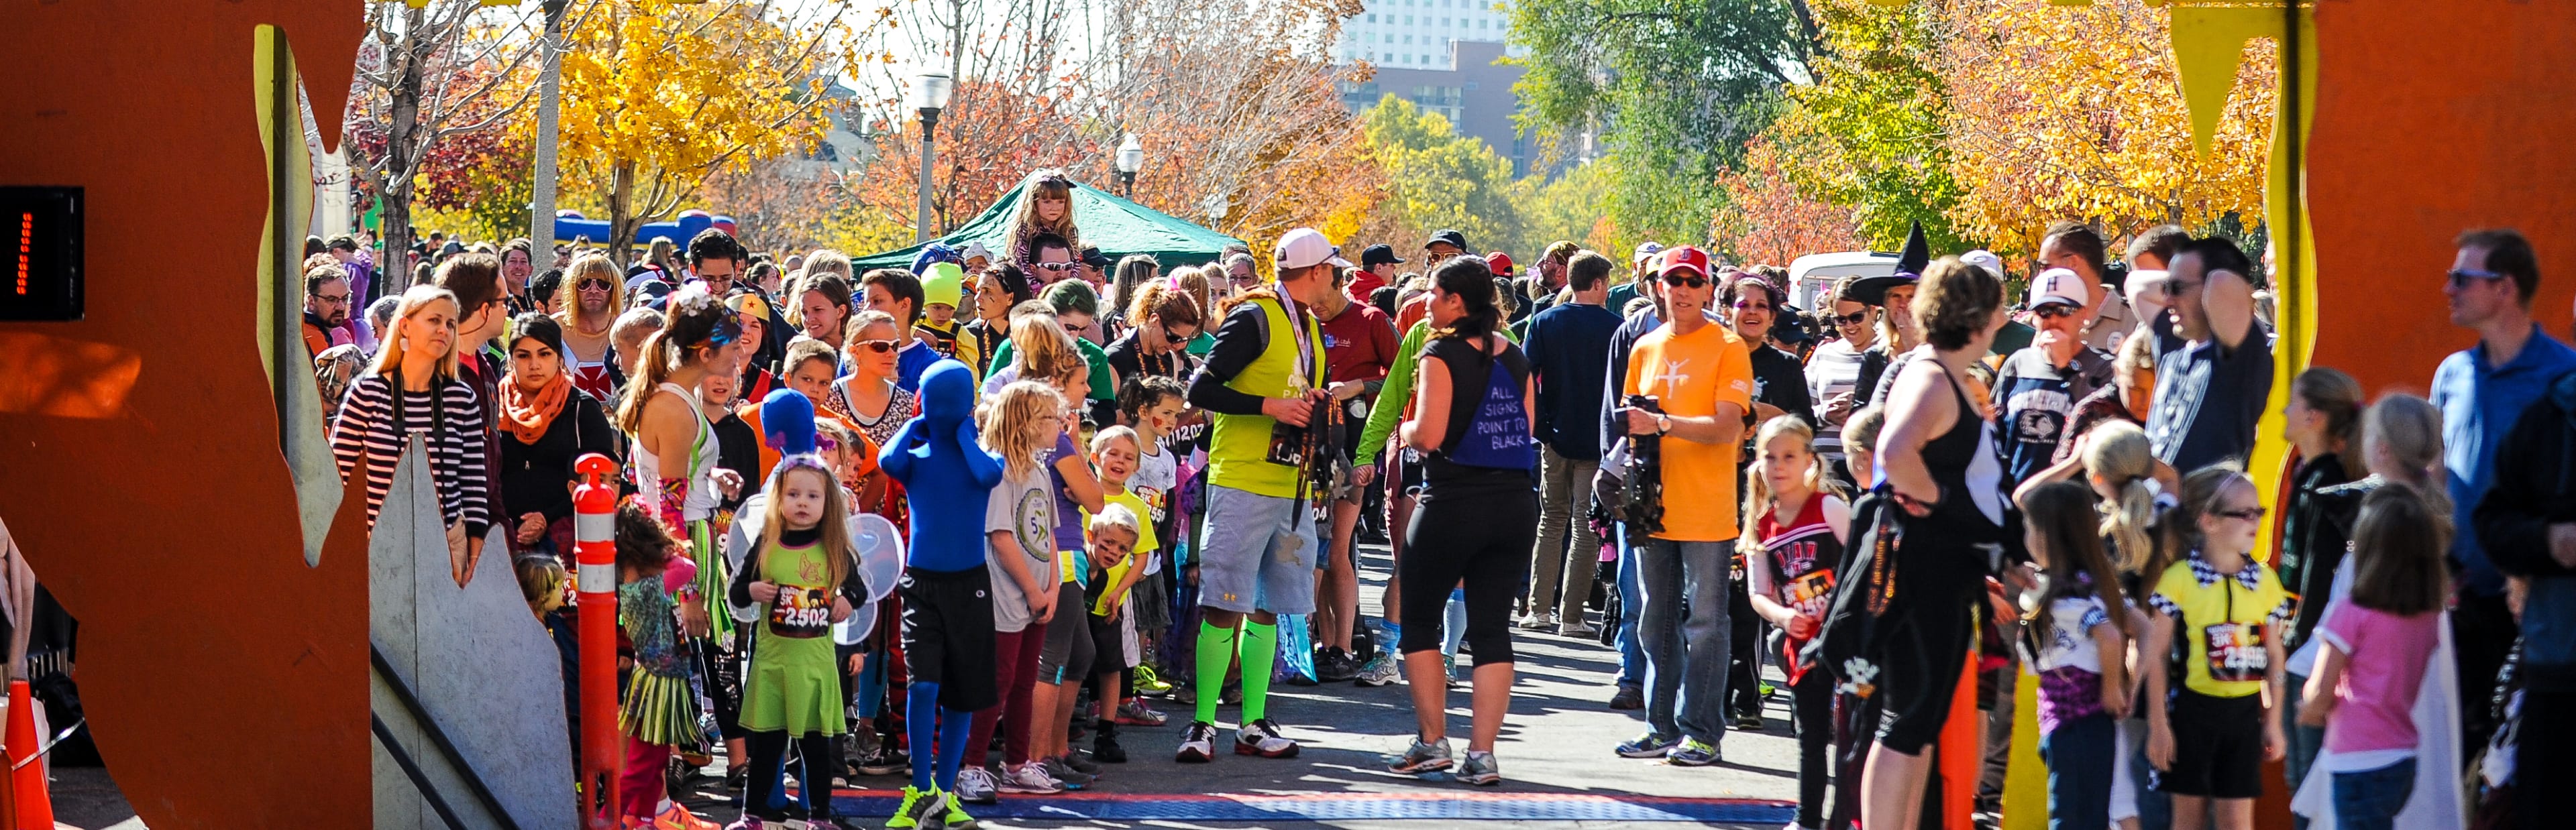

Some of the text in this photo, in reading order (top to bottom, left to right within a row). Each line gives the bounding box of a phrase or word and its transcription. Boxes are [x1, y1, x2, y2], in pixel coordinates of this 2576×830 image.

[2046, 275, 2058, 292] H
[1491, 387, 1514, 400] ALL
[1485, 400, 1519, 417] SIGNS
[1477, 416, 1526, 435] POINT TO
[1491, 434, 1525, 450] BLACK
[784, 607, 829, 628] 2502
